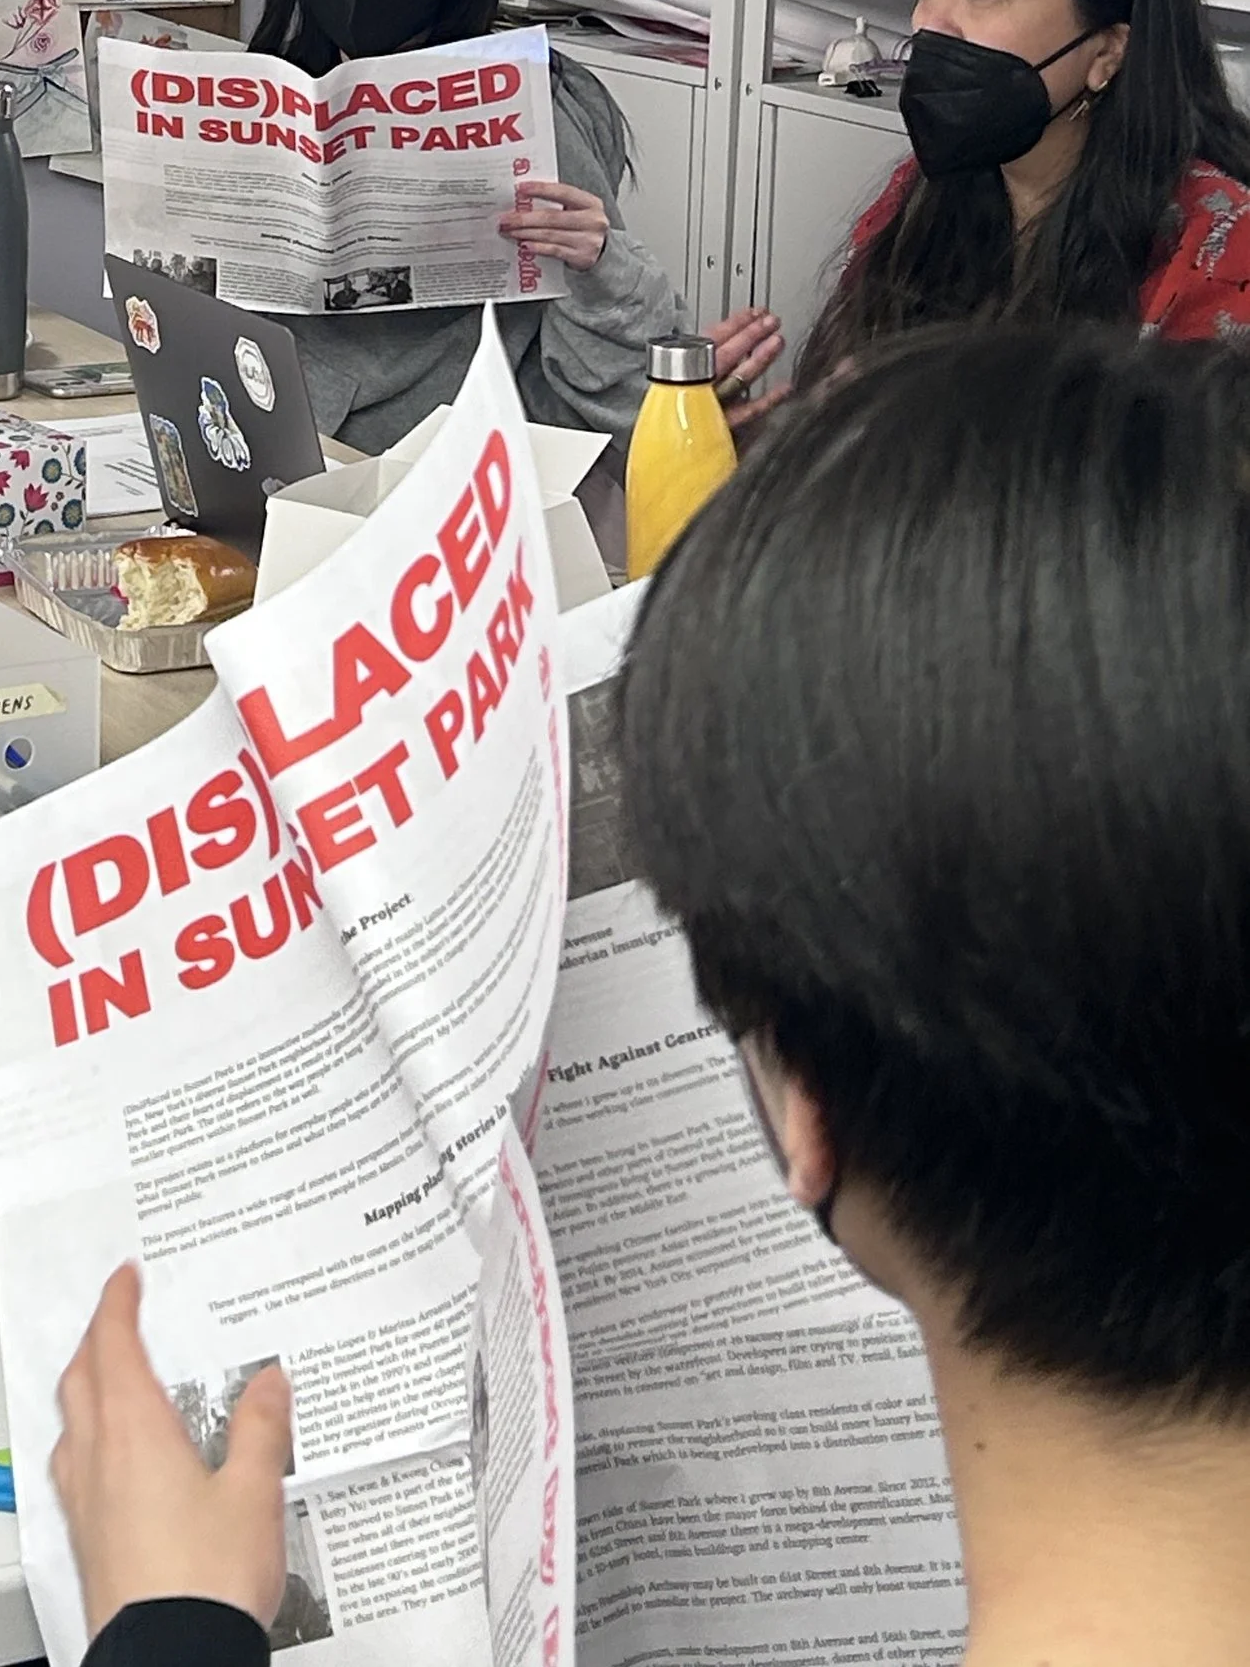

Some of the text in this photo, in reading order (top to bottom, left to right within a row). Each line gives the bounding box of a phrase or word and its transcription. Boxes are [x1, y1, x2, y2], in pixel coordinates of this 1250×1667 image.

[130, 62, 521, 131] (DIS)PLACED
[136, 111, 525, 166] IN SUNSET PARK
[27, 429, 513, 967] (DIS)LACED
[48, 539, 535, 1047] IN PARK
[359, 893, 413, 930] Project
[563, 926, 614, 950] Avenue
[548, 1042, 660, 1083] Fight Against
[363, 1182, 423, 1227] Mapping
[456, 1117, 494, 1151] stories
[430, 1492, 452, 1507] Park
[401, 1596, 428, 1613] They
